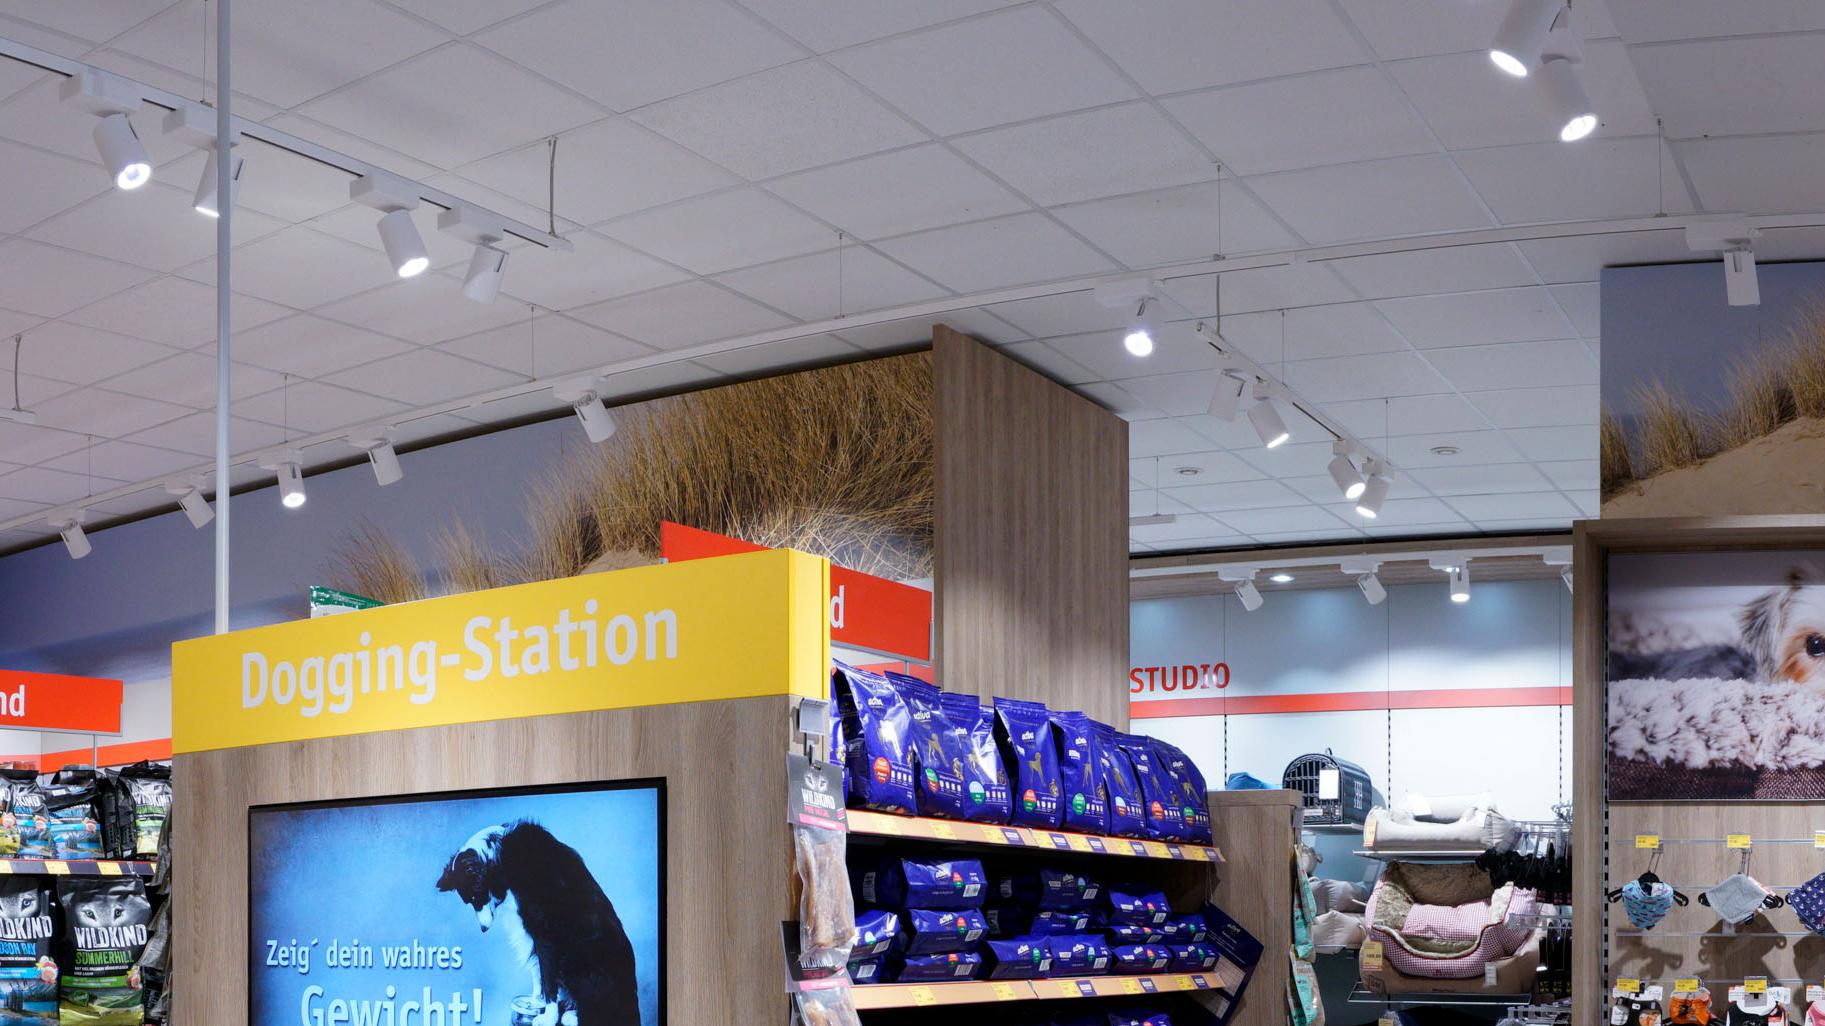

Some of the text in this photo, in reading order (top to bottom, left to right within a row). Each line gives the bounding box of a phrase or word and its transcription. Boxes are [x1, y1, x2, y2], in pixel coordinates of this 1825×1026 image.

[241, 598, 679, 718] Dogging-Station
[1130, 663, 1230, 693] STUDIO
[74, 924, 148, 949] WILDKIND
[326, 939, 373, 968] dein
[382, 942, 463, 970] wahres
